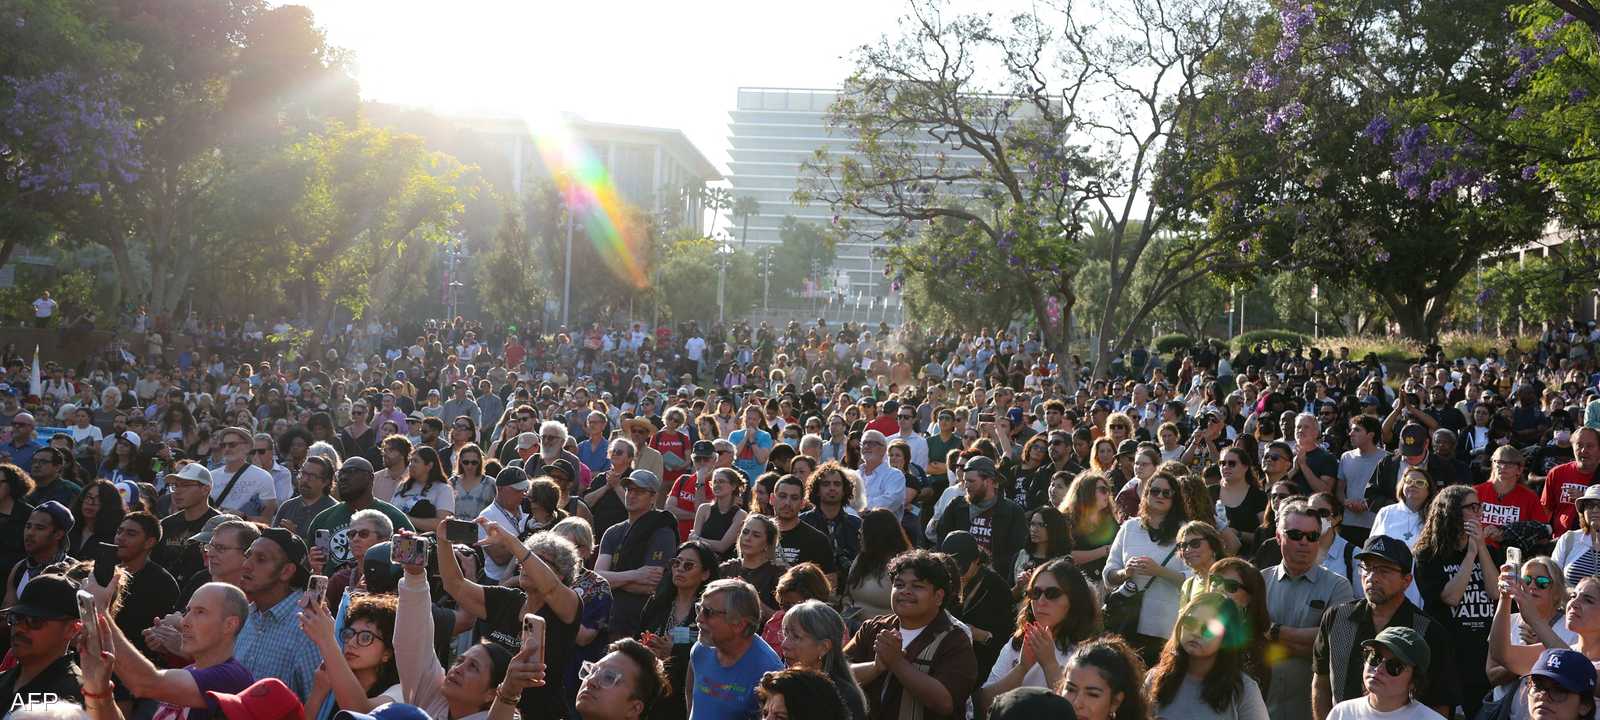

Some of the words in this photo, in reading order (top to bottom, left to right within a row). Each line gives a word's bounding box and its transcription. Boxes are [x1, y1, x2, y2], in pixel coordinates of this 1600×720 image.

[1483, 503, 1518, 515] UNITE
[1481, 513, 1517, 525] HERE!
[1462, 591, 1489, 604] WIS
[1547, 654, 1561, 669] LA
